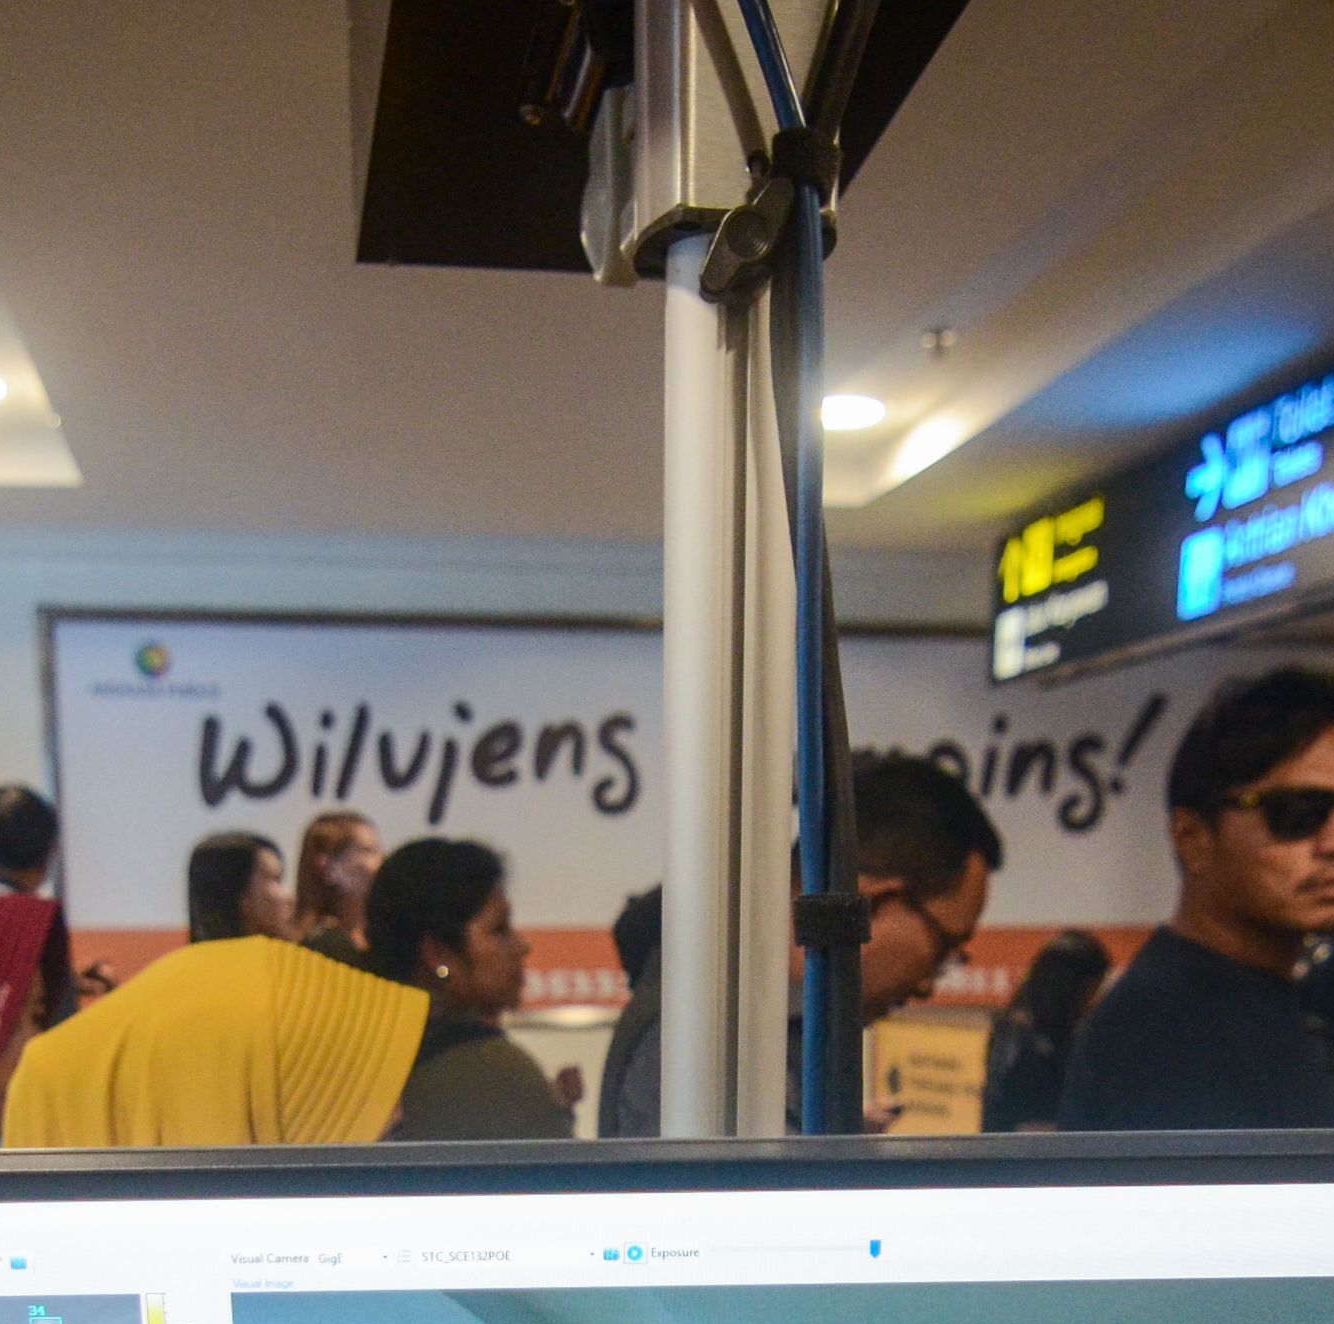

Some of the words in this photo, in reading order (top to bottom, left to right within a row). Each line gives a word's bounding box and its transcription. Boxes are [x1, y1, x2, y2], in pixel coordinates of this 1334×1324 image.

[231, 1254, 264, 1265] Visual
[267, 1253, 309, 1265] Camera
[651, 1247, 700, 1260] Exposure
[233, 1278, 262, 1289] Visual
[265, 1277, 295, 1290] Image
[29, 1304, 47, 1317] 34
